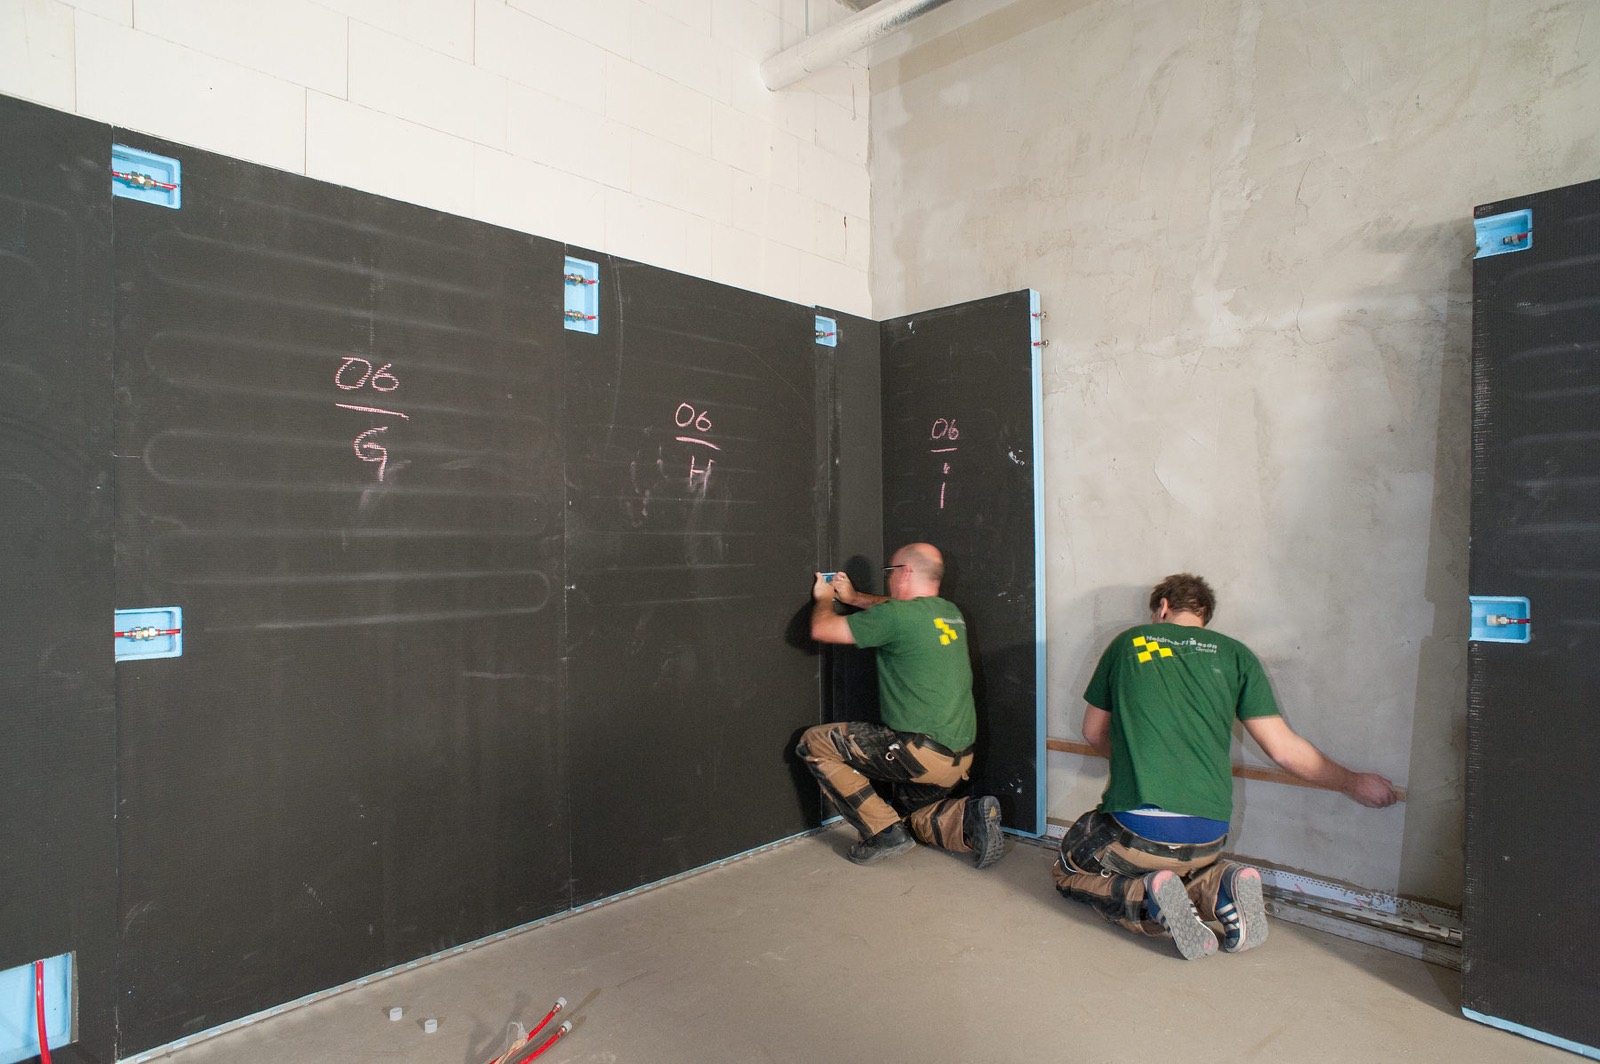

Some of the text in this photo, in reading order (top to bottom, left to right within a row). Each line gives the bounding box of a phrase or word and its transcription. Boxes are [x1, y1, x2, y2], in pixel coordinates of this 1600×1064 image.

[335, 356, 400, 392] 06
[675, 402, 712, 432] 06
[931, 417, 959, 440] 06
[689, 455, 716, 498] H
